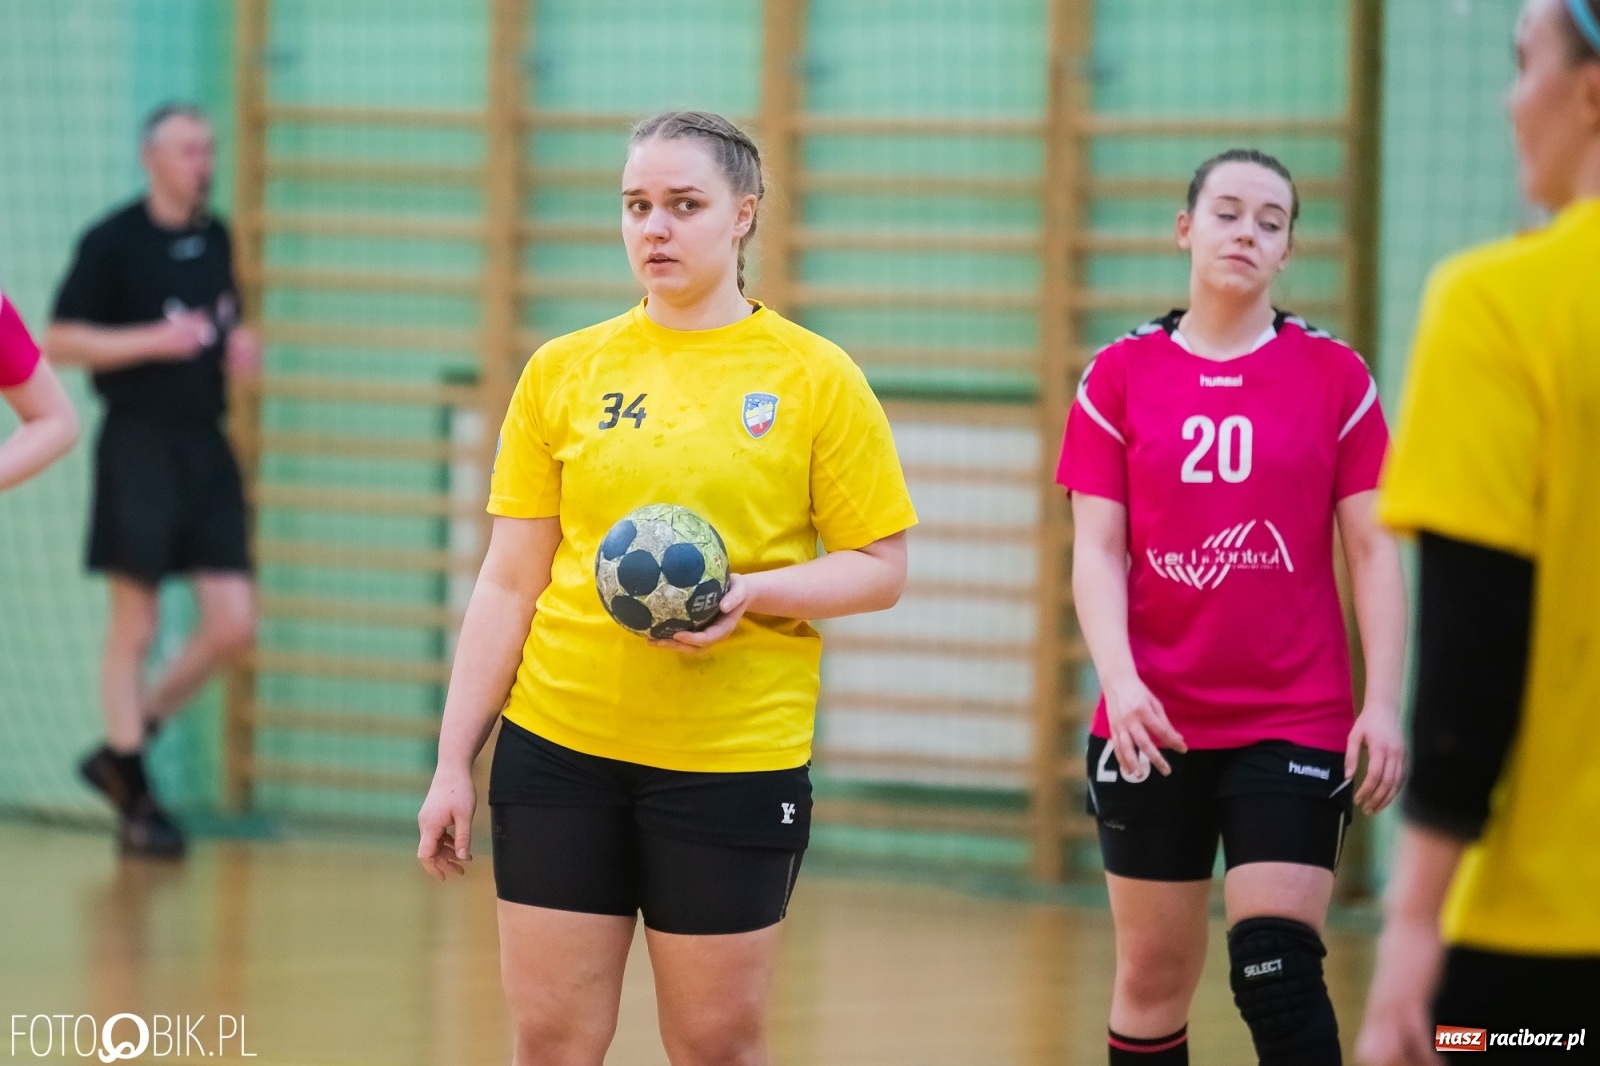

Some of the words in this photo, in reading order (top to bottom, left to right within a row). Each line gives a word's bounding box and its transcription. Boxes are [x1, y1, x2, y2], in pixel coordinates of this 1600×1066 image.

[1200, 373, 1243, 387] hummel
[598, 392, 648, 430] 34
[1181, 414, 1253, 483] 20
[1288, 760, 1330, 781] hummel
[1243, 958, 1282, 978] SELECT
